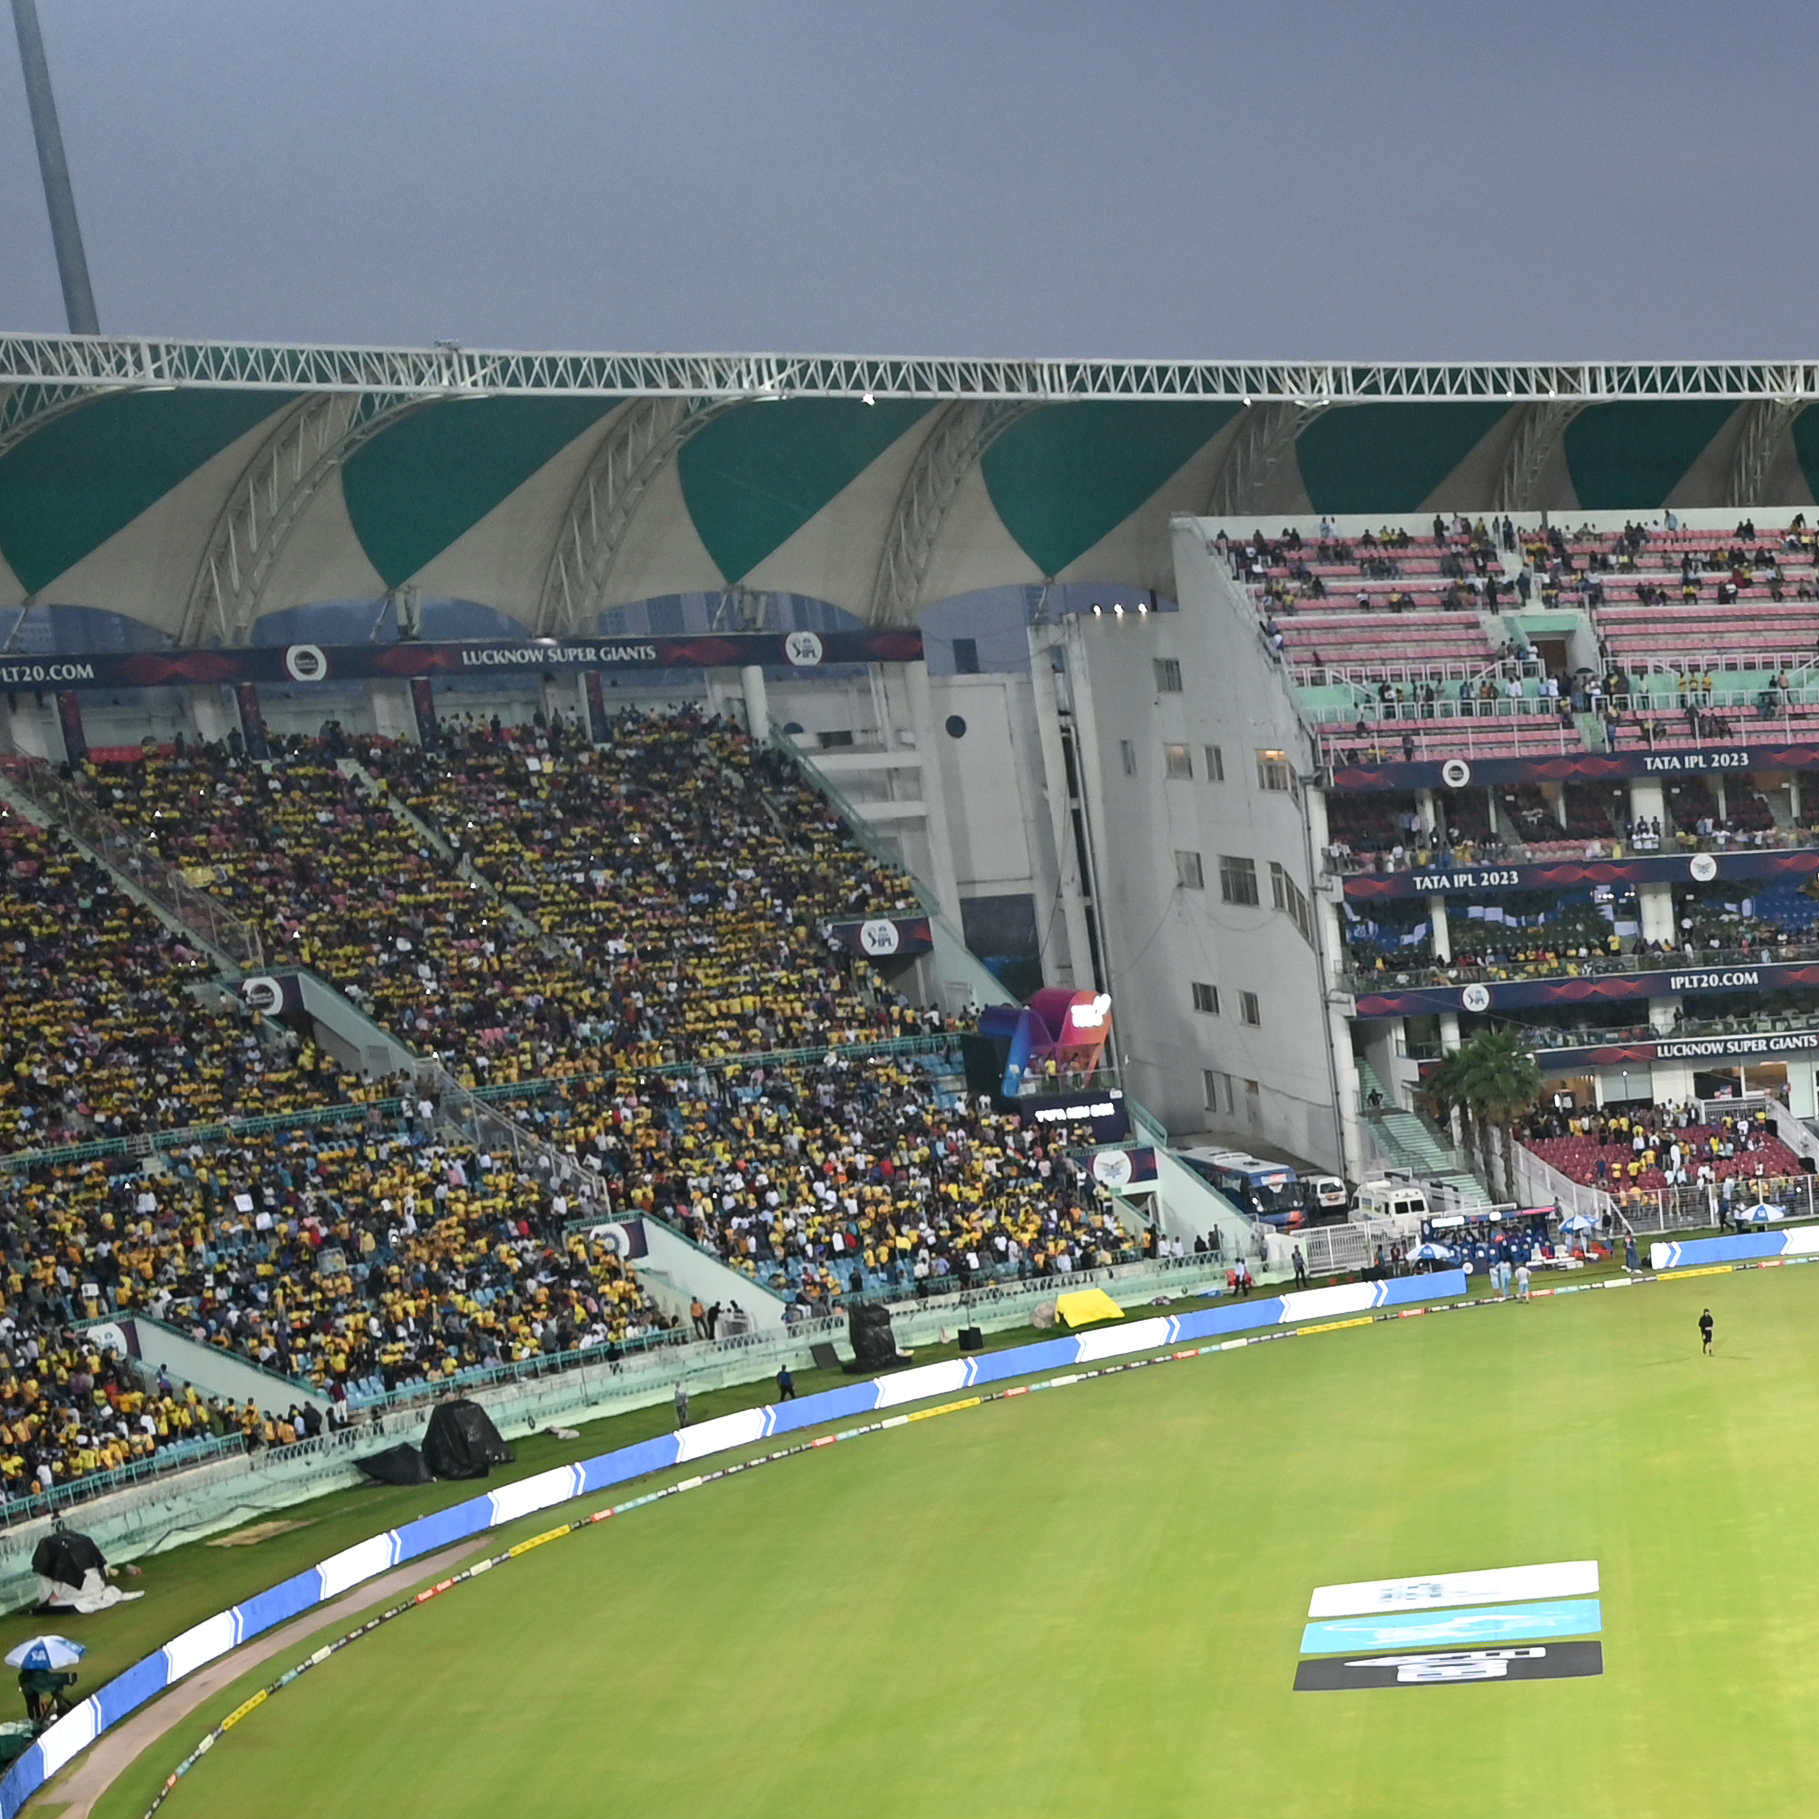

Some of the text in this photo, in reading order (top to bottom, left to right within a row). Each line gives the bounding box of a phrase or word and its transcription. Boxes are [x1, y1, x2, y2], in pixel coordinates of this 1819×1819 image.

[462, 645, 656, 666] LUCKNOW SUPER GIANTS
[0, 663, 95, 683] LT20.COM
[1644, 753, 1750, 771] TATA IPL 2023
[1413, 871, 1519, 890] TATA IPL 2023
[1670, 972, 1759, 990] IPLT20.COM
[1657, 1035, 1818, 1058] LUCKNOW SUPER GIANTS
